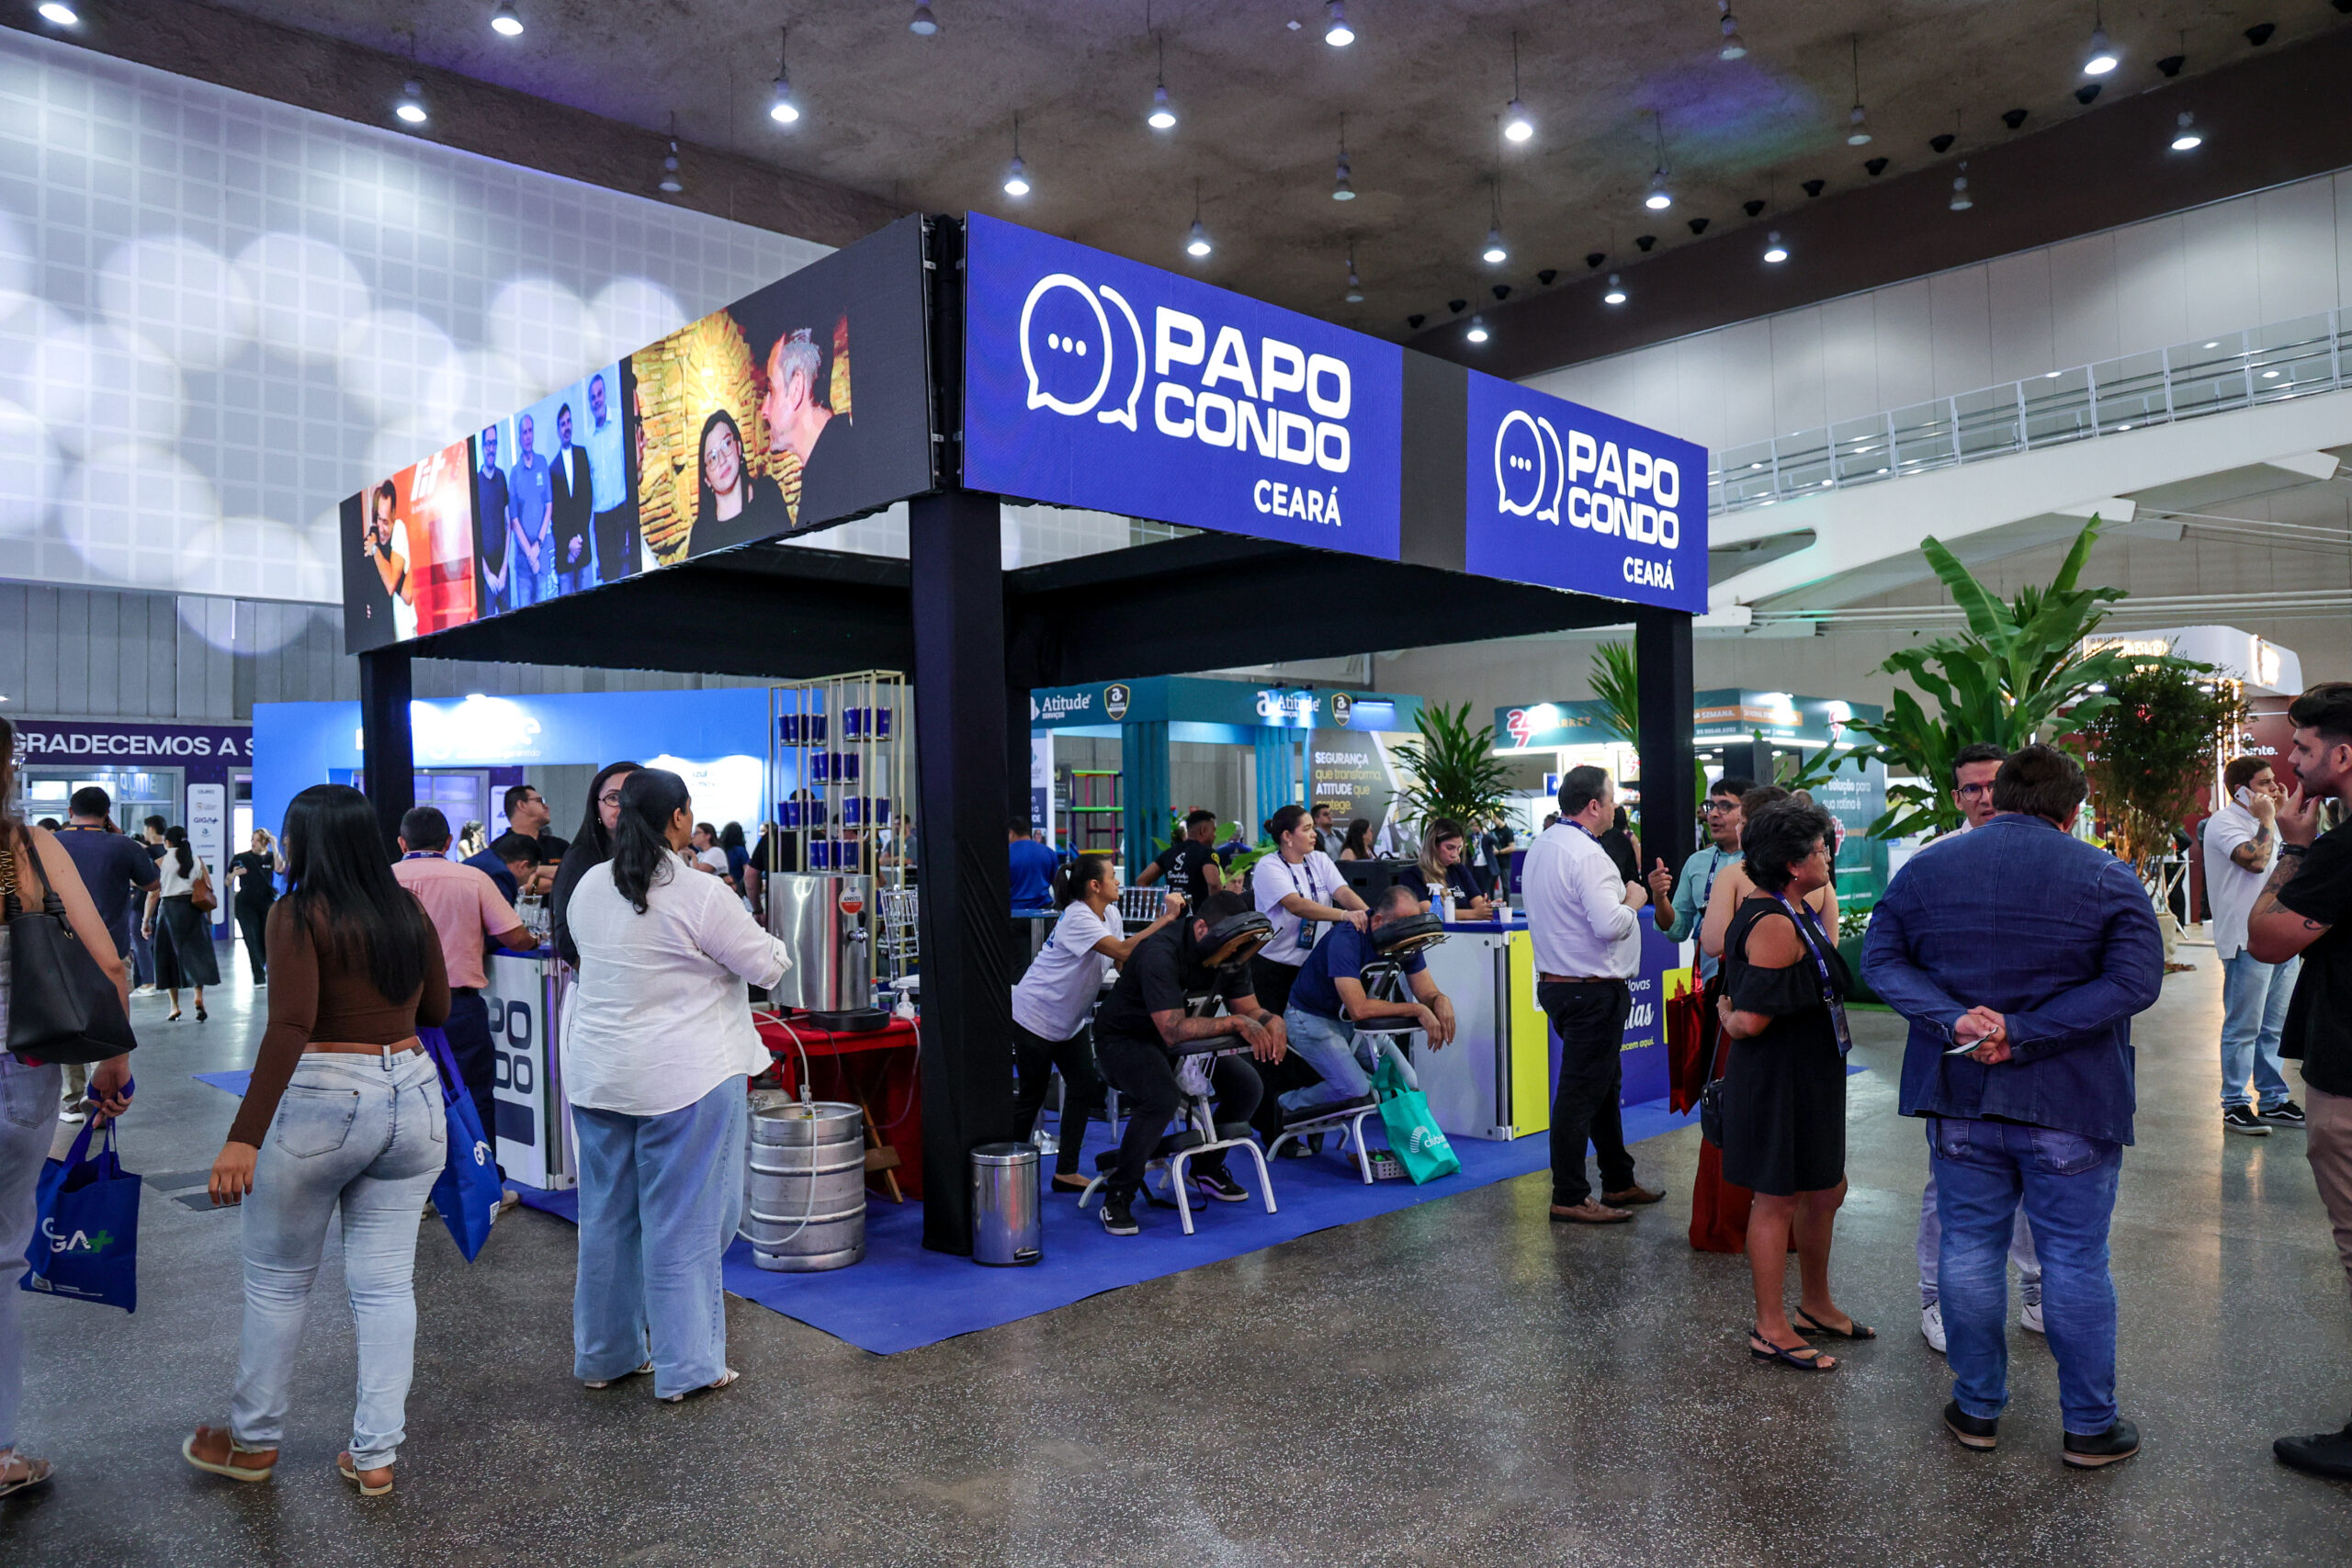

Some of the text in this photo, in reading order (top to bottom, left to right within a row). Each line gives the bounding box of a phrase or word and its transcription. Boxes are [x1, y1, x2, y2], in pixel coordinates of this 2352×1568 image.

[1155, 305, 1351, 420] PAPO
[1154, 381, 1351, 473] CONDO
[1567, 429, 1679, 509] PAPO
[1253, 479, 1342, 527] CEARÁ
[1567, 486, 1679, 550] CONDO
[1623, 556, 1675, 591] CEARÁ
[1042, 693, 1091, 713] Atitude
[1277, 694, 1319, 712] Atitde
[218, 738, 238, 756] A
[1315, 751, 1369, 768] SEGURANÇA
[1316, 770, 1333, 783] que
[1316, 783, 1371, 797] ATITUDE que
[1828, 779, 1855, 795] solução
[1856, 782, 1871, 795] para
